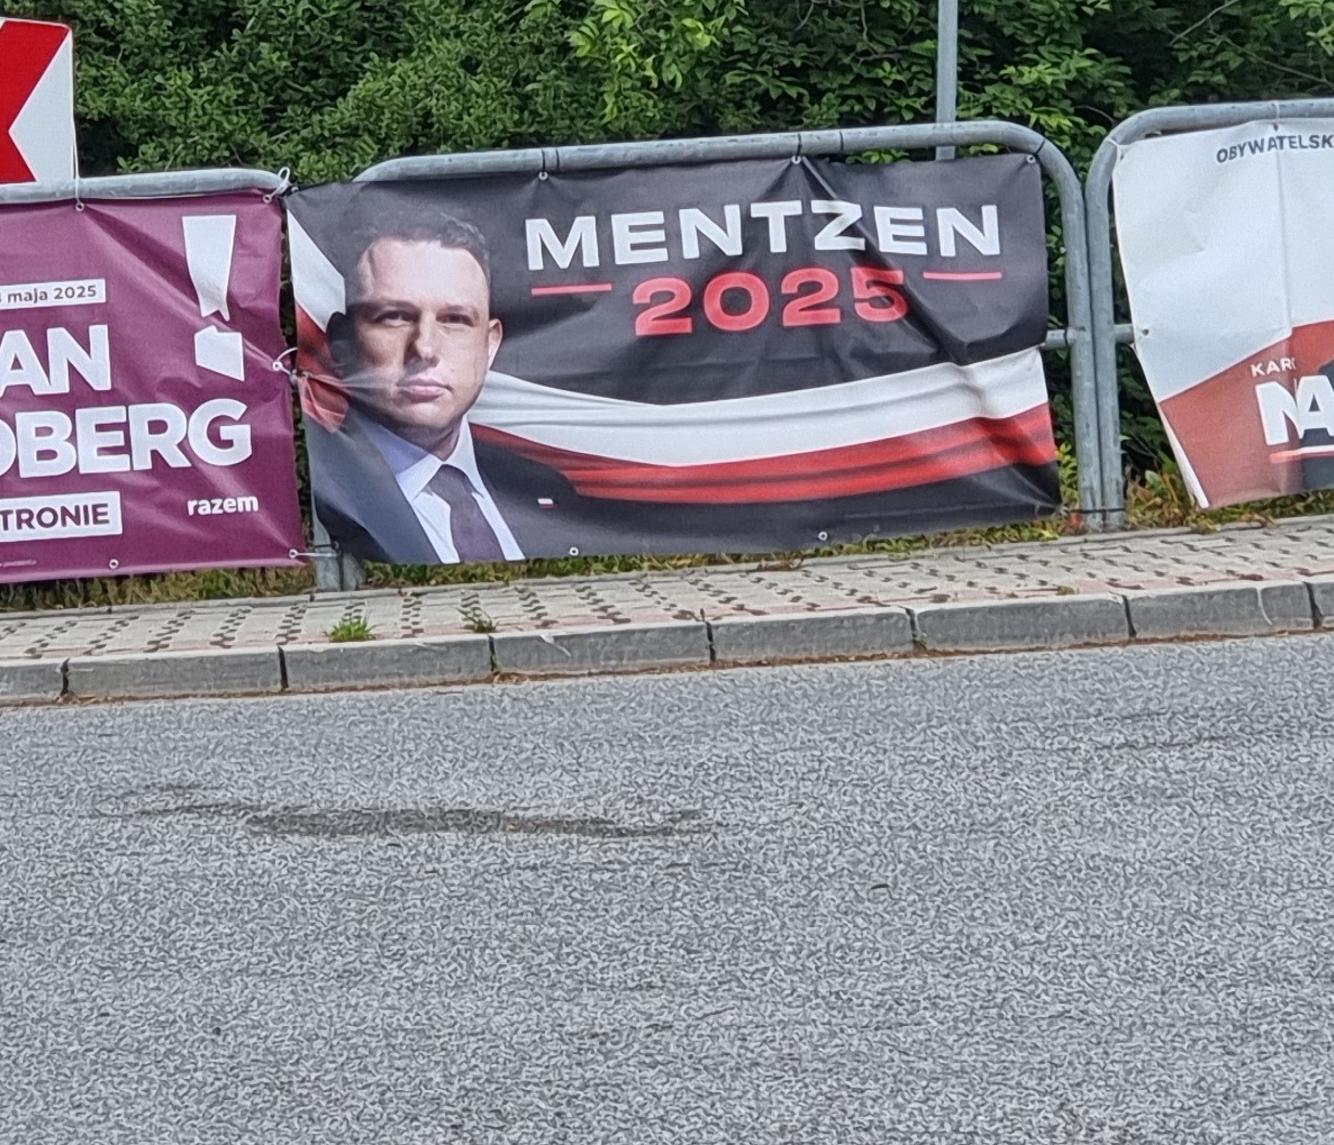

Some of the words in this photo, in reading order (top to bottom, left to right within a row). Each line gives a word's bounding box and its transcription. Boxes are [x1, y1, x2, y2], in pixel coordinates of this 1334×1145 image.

[524, 199, 1001, 271] MENTZEN
[7, 287, 48, 304] maja
[53, 284, 97, 300] 2025
[632, 267, 911, 337] 2025
[1250, 357, 1296, 377] KAR
[187, 496, 259, 516] razem
